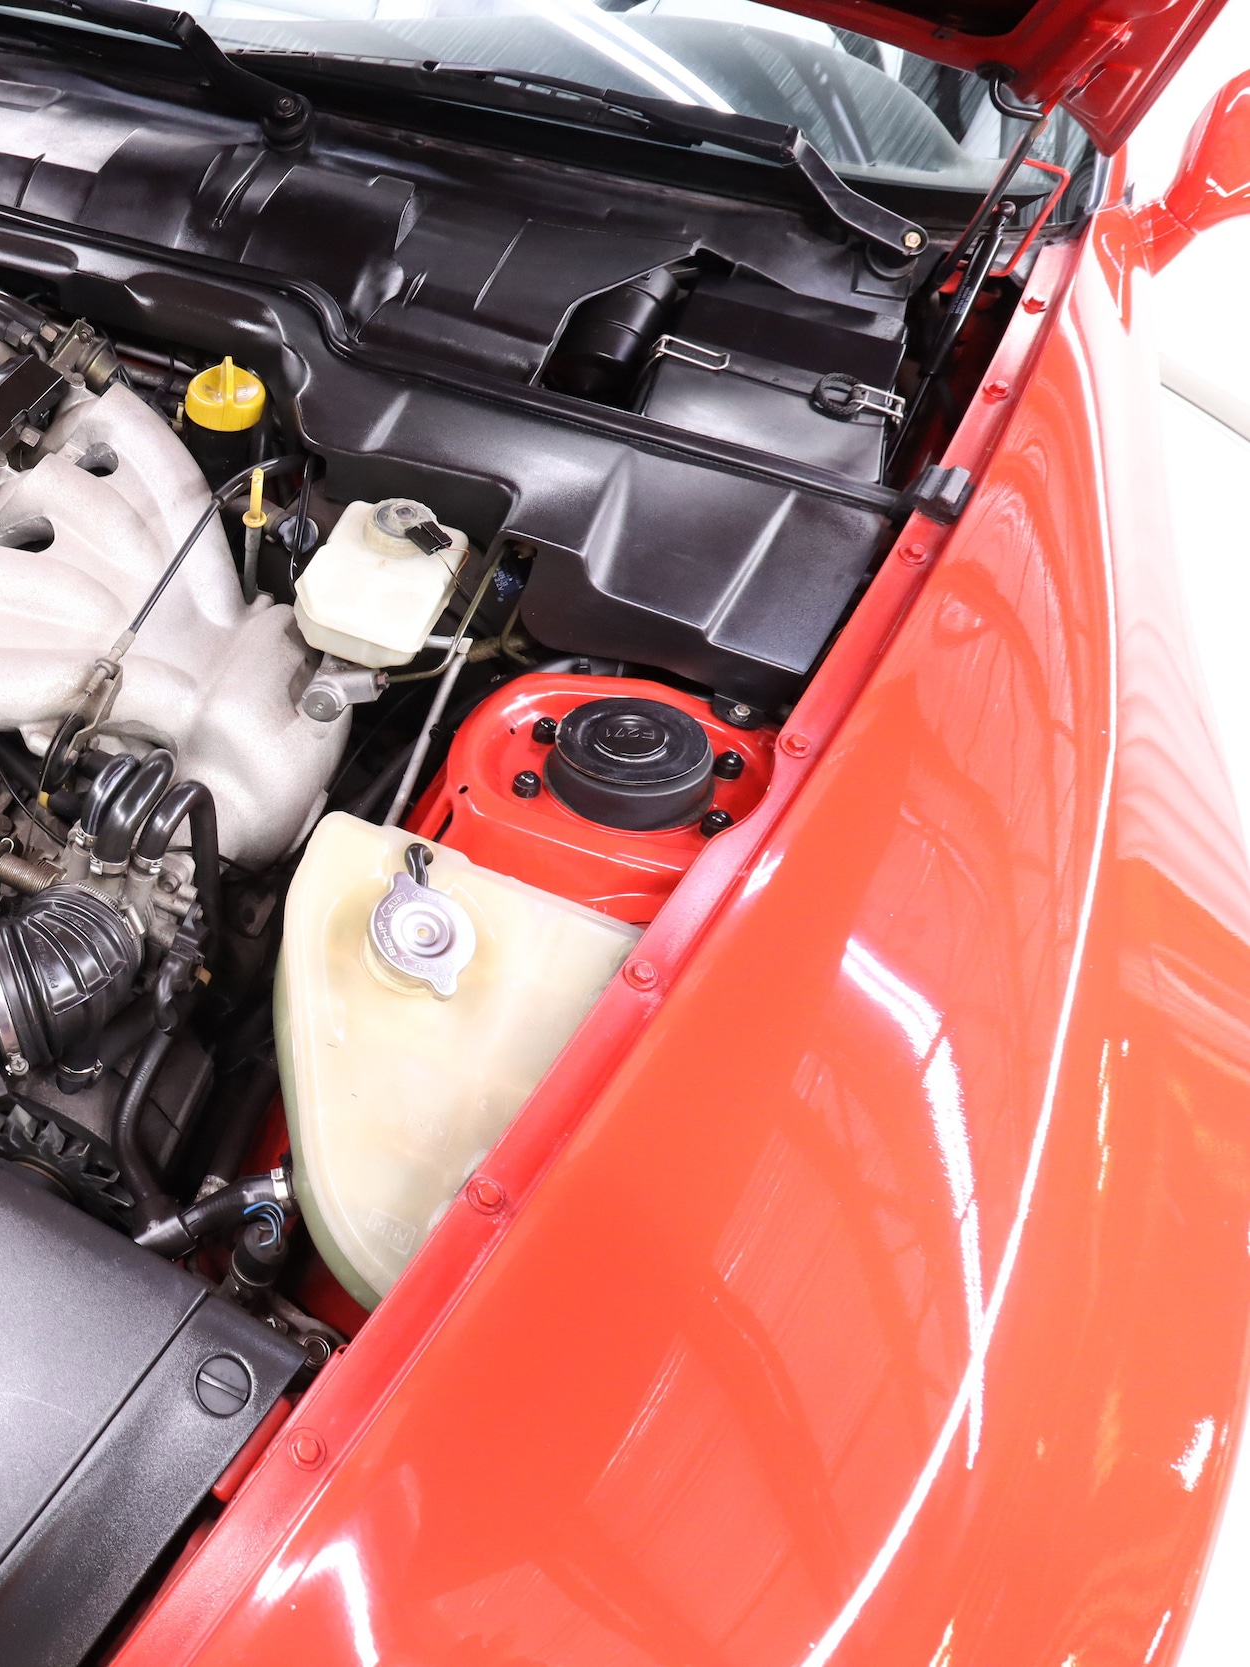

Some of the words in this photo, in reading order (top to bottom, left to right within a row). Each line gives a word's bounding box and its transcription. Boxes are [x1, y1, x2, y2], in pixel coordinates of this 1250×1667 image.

[605, 727, 655, 740] F271
[387, 895, 403, 911] AUF
[414, 963, 430, 971] ZU
[372, 1216, 409, 1242] MIN
